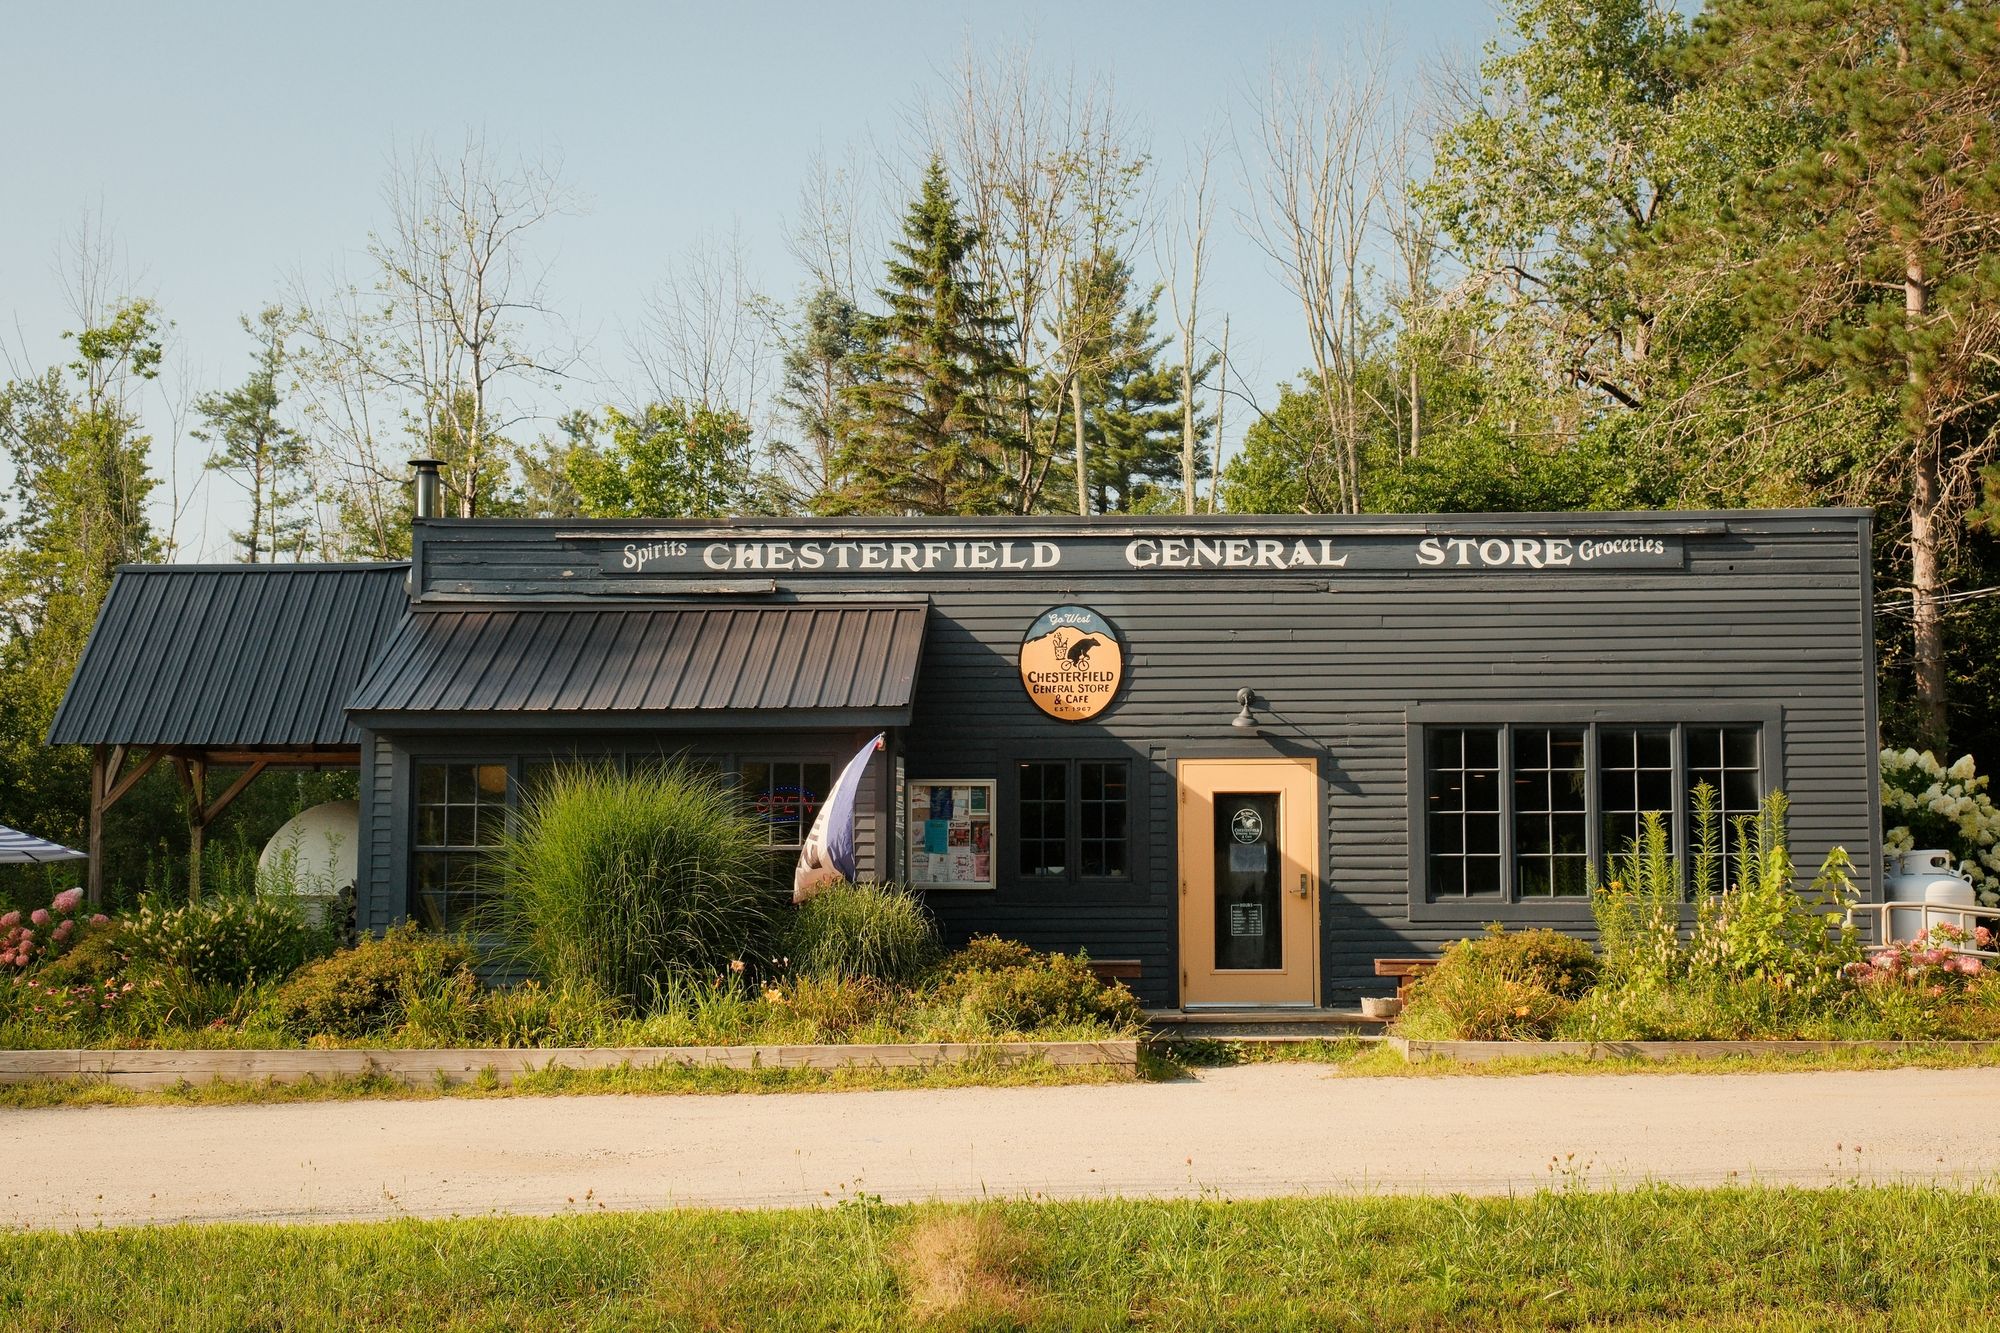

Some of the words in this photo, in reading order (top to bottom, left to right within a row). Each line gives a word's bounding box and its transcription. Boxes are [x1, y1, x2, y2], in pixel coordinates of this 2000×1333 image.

[703, 541, 1061, 572] CHESTERFIELD
[1125, 538, 1349, 569] GENERAL
[1415, 537, 1574, 569] STORE
[1578, 537, 1664, 561] Groceries
[622, 541, 687, 572] Spirits
[1048, 613, 1064, 626] Go
[1064, 613, 1091, 624] West
[1028, 671, 1113, 683] CHESTERFIELD
[1033, 684, 1074, 693] GENERAL
[1077, 684, 1110, 693] STORE
[1054, 694, 1062, 705] &
[1065, 694, 1089, 704] CAFE
